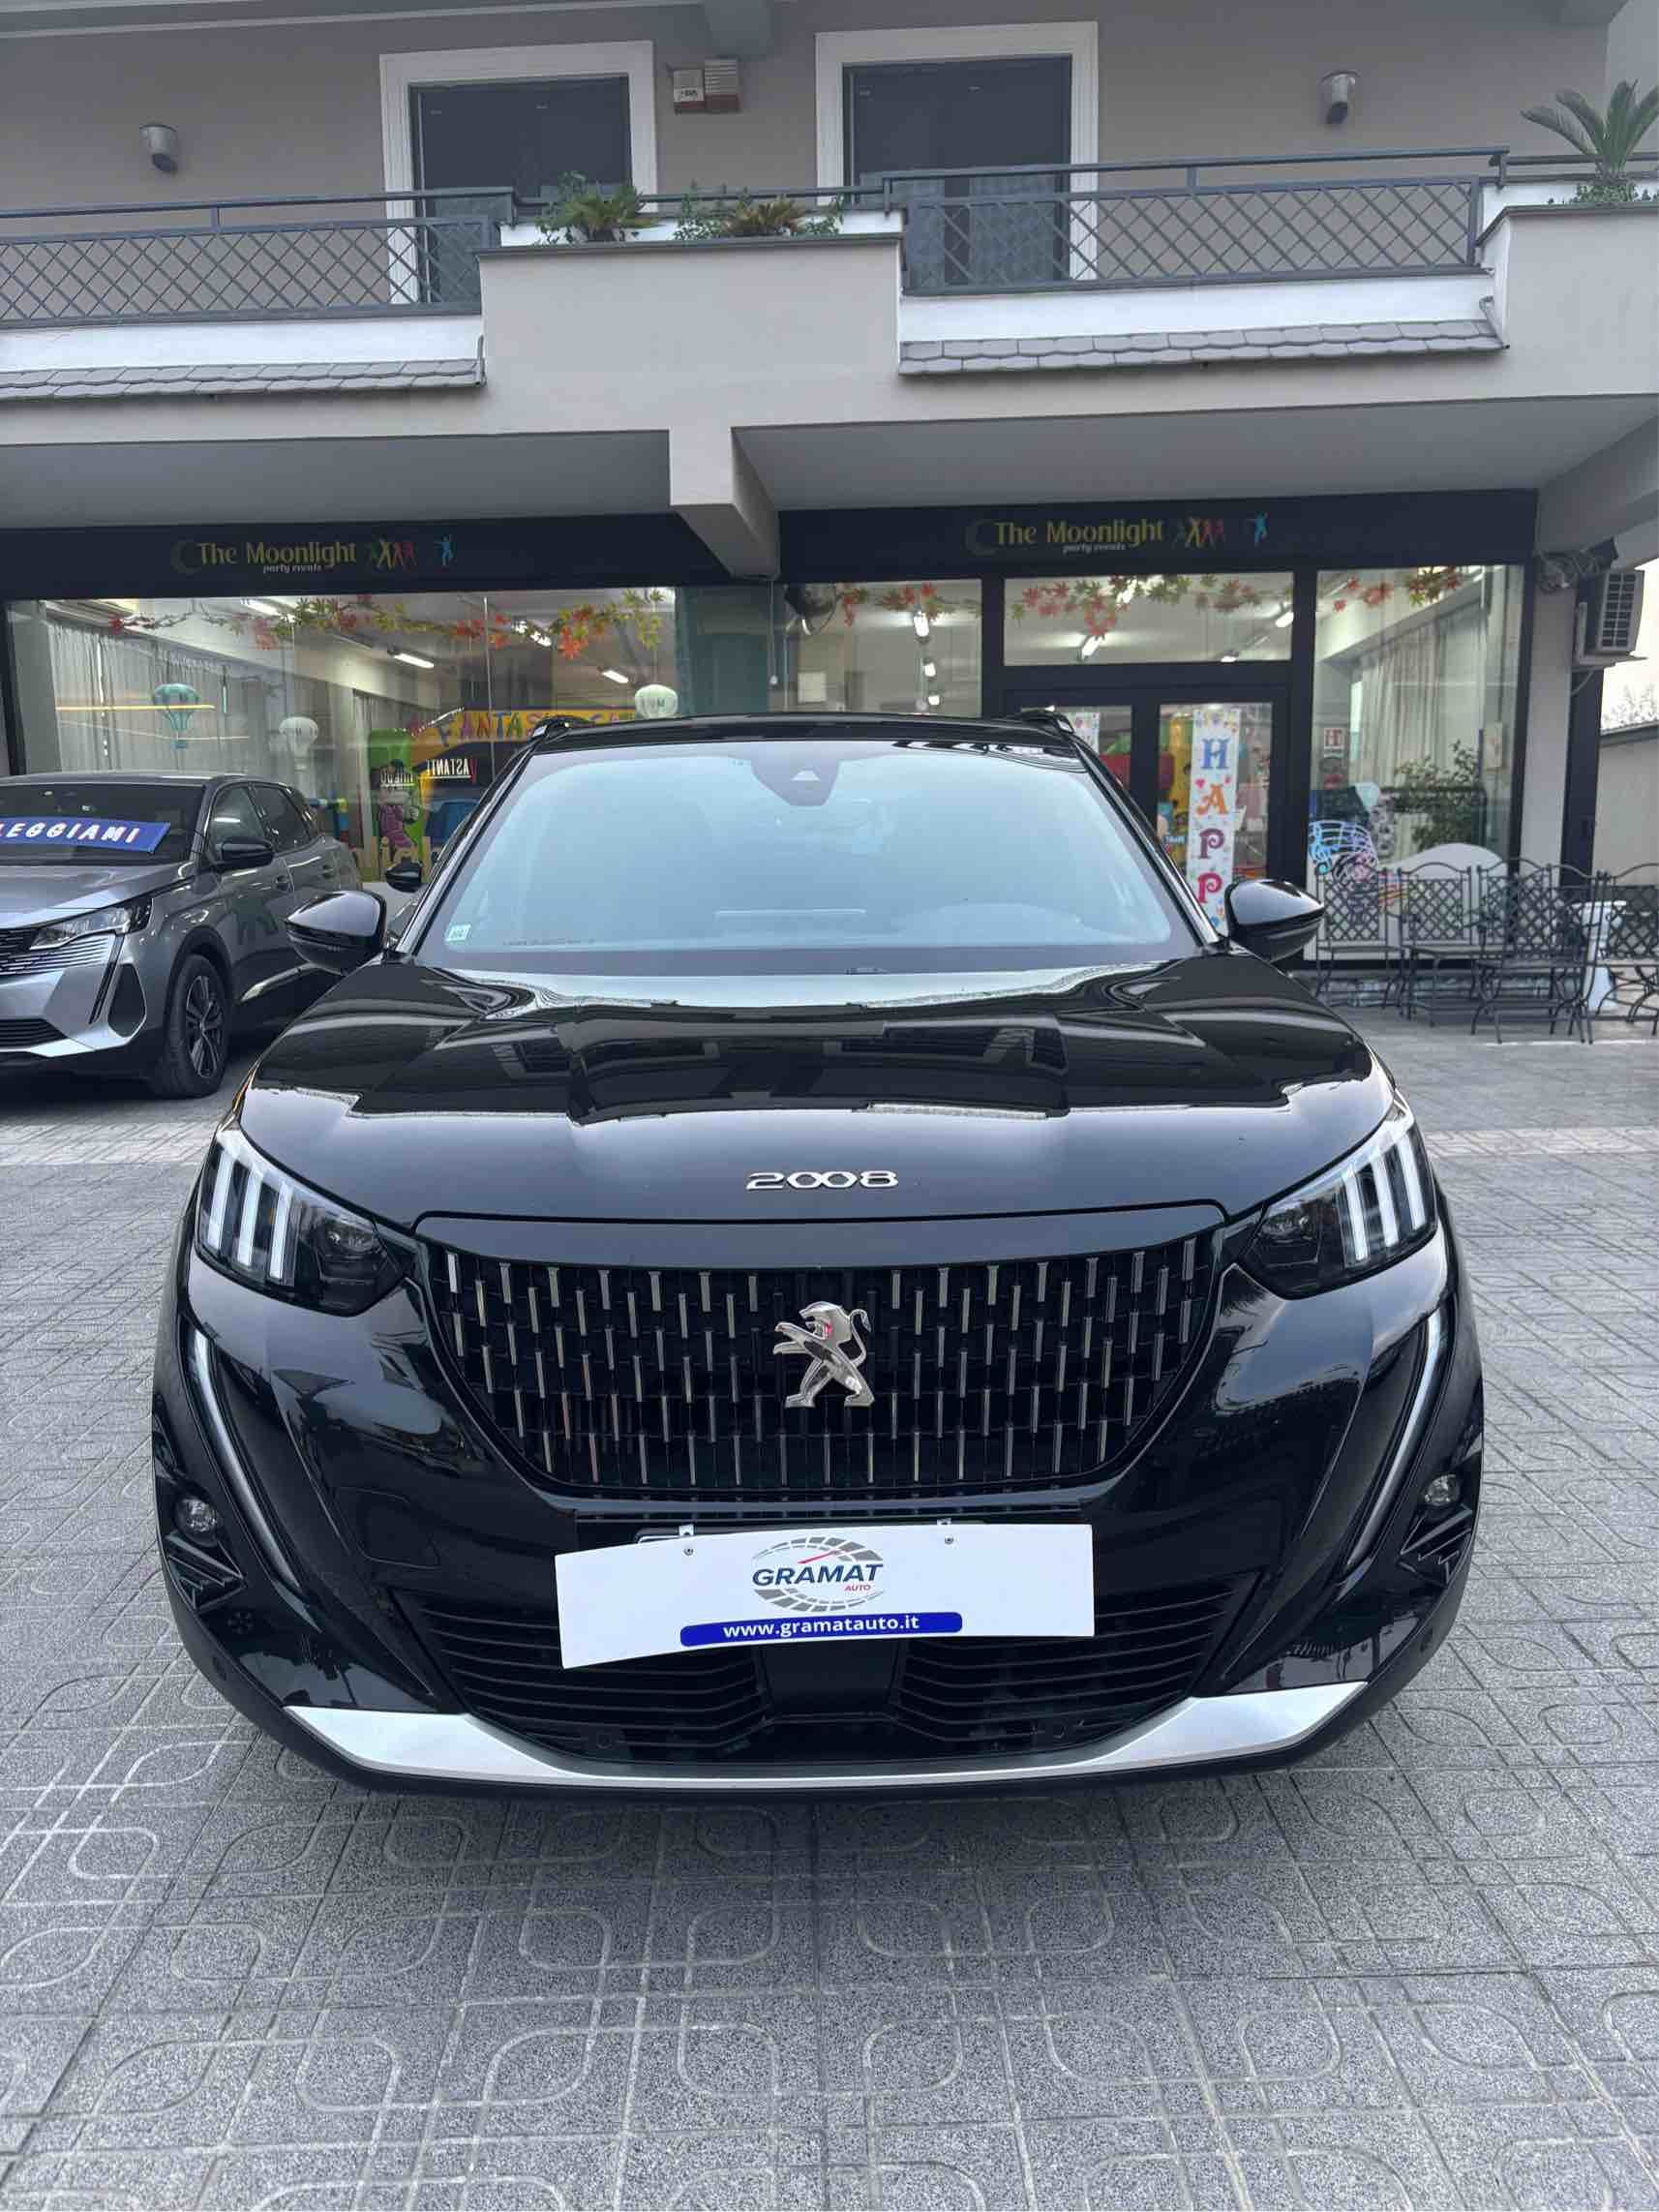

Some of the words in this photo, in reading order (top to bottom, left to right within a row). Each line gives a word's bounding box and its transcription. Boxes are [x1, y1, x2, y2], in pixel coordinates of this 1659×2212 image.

[993, 521, 1038, 545] The
[1046, 519, 1163, 547] Moonlight
[196, 541, 239, 564] The
[246, 541, 356, 568] Moonlight
[1195, 738, 1230, 905] HAPP
[745, 1169, 899, 1191] 2008
[752, 1563, 884, 1587] GRAMAT
[844, 1583, 871, 1592] AUTO
[723, 1614, 920, 1639] www.gramatauto.it
